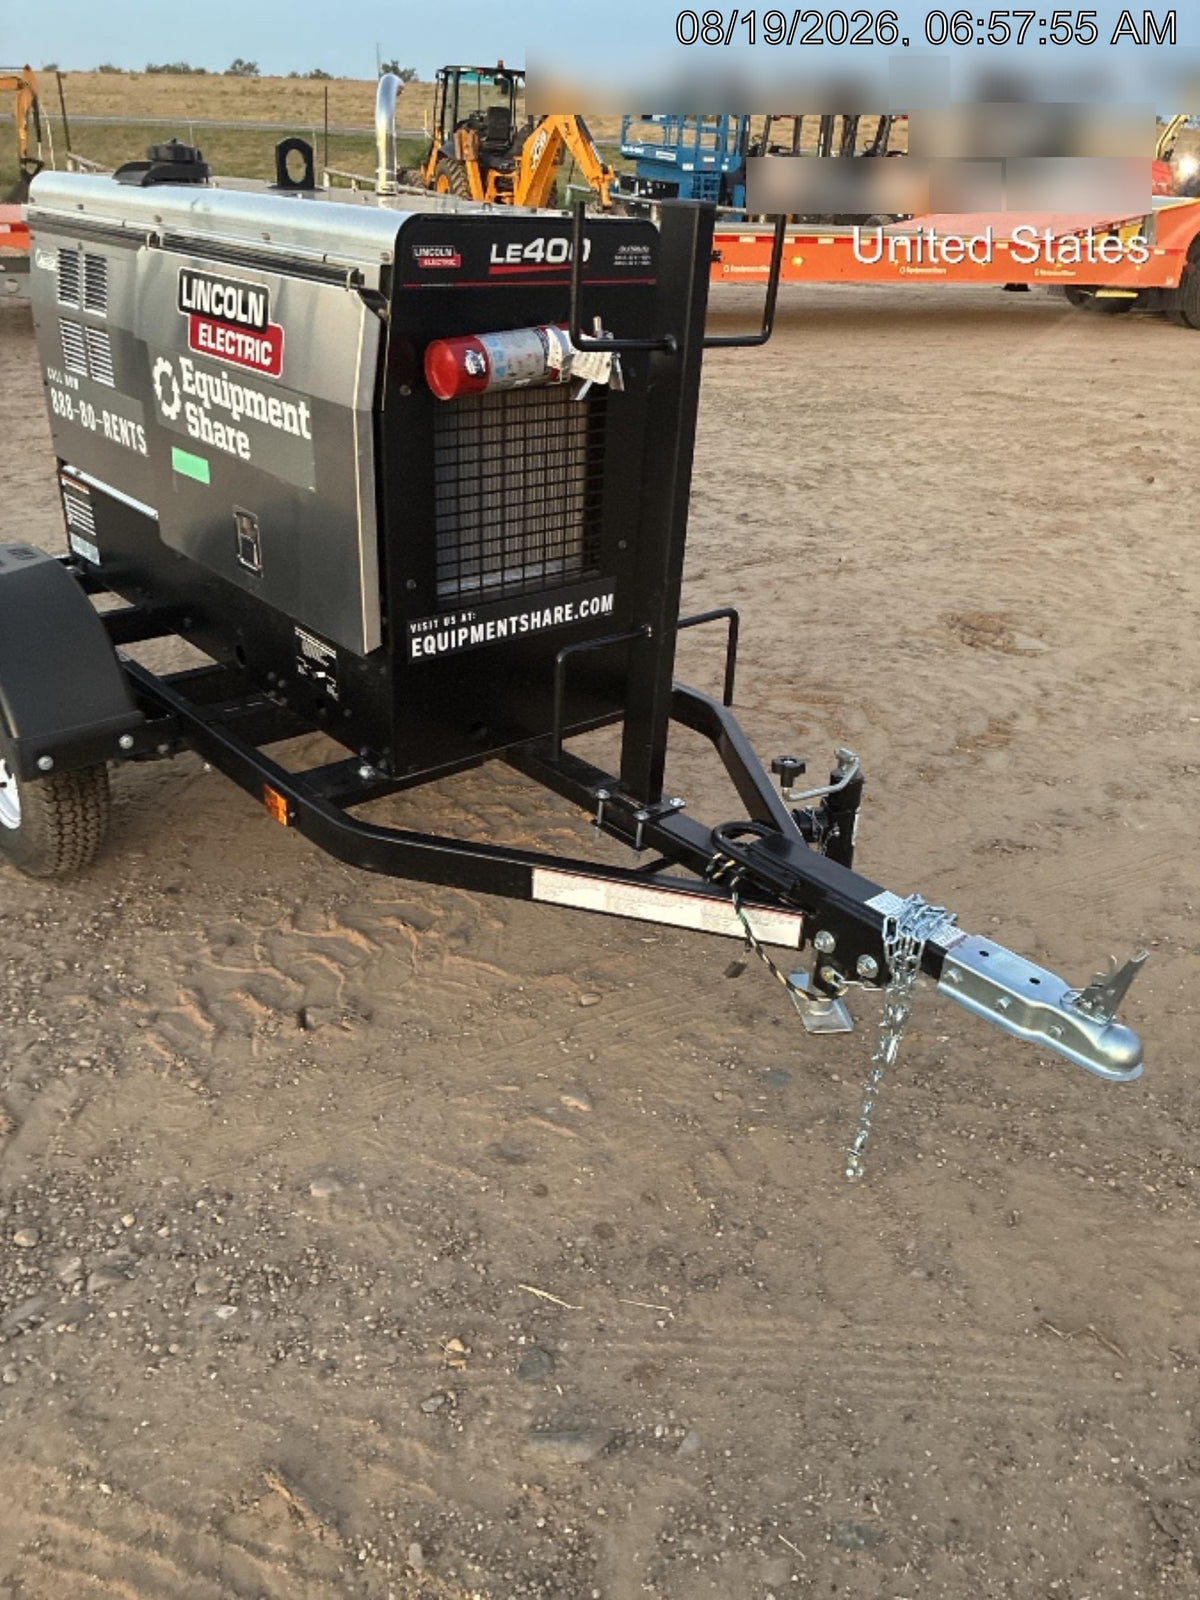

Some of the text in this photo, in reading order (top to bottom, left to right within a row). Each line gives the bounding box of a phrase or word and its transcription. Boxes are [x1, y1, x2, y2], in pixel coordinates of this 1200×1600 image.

[182, 275, 264, 328] LINCOLN
[198, 322, 273, 366] ELECTRIC
[51, 387, 148, 455] 888-80-RENTS
[179, 355, 312, 440] Equipment
[184, 401, 251, 461] Share
[410, 619, 439, 634] VISIT
[444, 616, 456, 628] US
[411, 593, 615, 658] EQUIPMENTSHARE.COM
